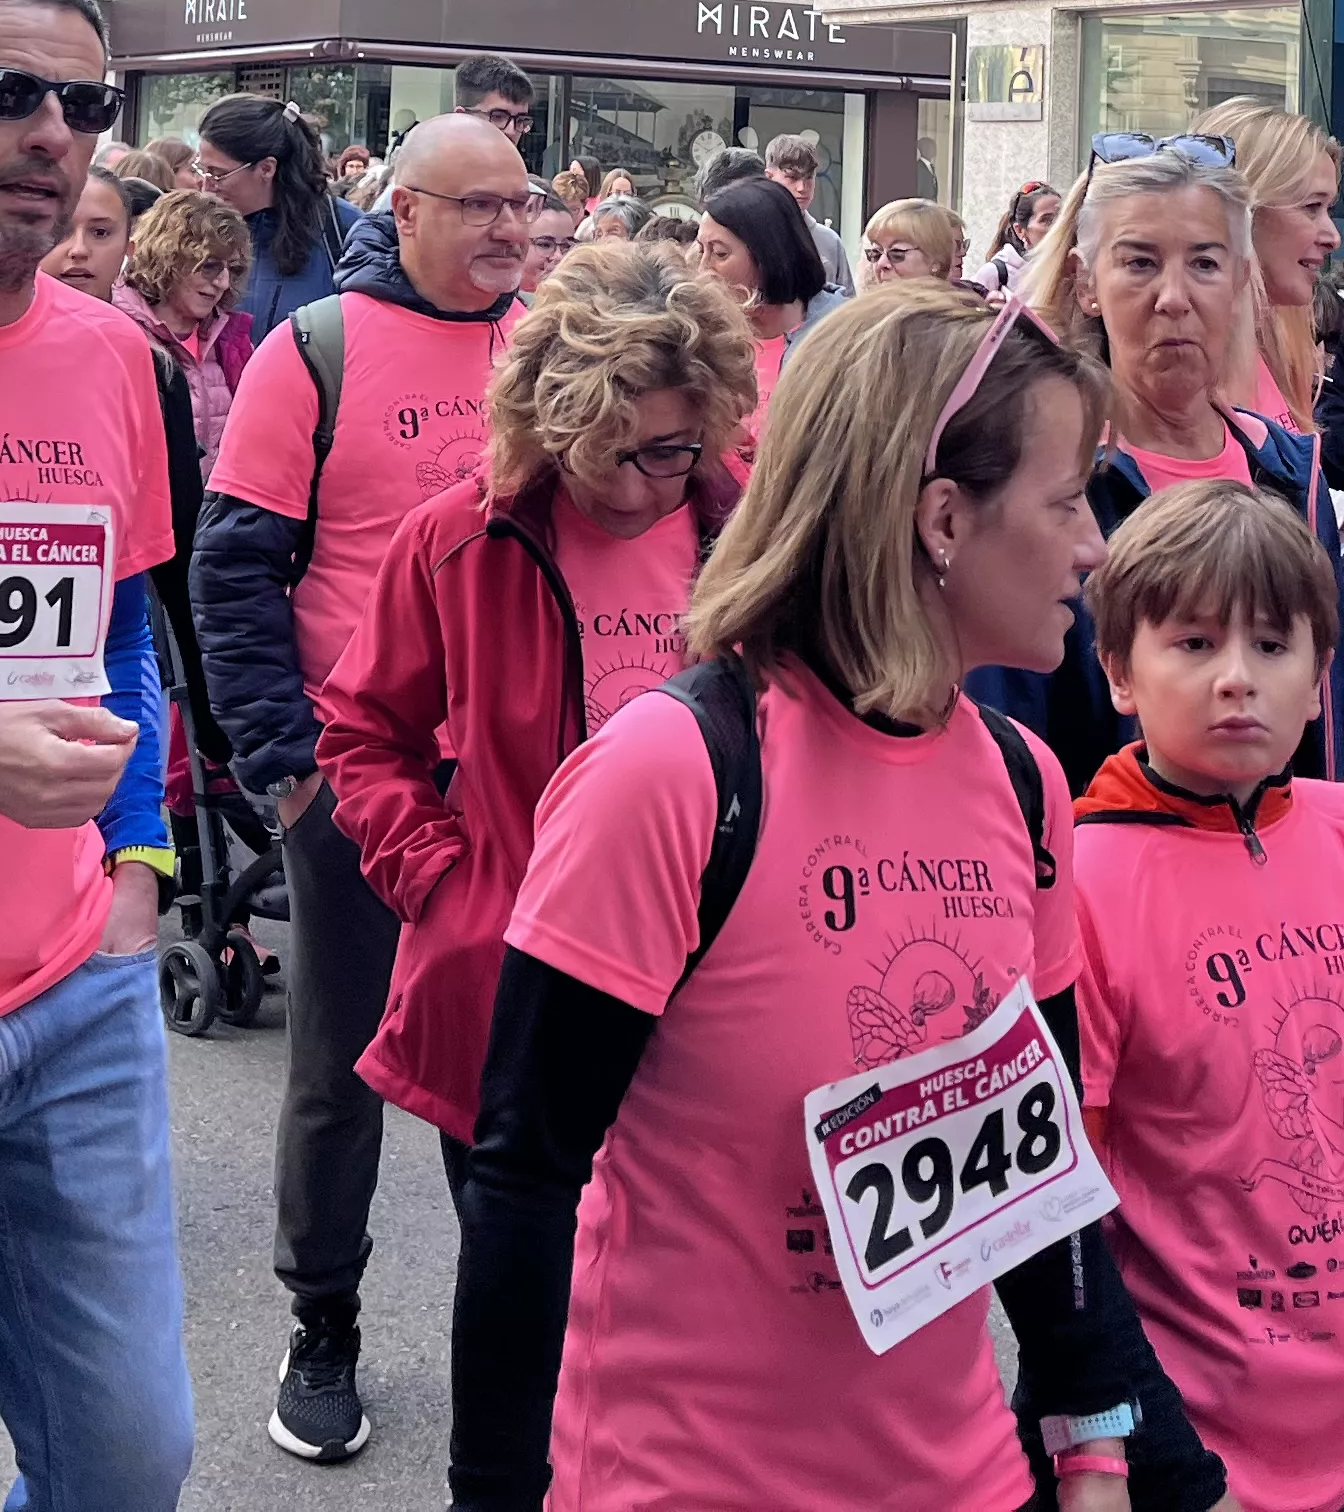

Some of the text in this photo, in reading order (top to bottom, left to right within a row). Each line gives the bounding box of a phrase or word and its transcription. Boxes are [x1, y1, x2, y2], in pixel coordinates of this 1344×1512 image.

[697, 1, 846, 44] MIRATE
[728, 46, 816, 62] MENSWEAR
[37, 466, 105, 488] HUESCA
[11, 543, 33, 562] EL
[36, 540, 99, 563] CÁNCER
[822, 850, 994, 932] 9ª CÁNCER
[942, 895, 1015, 919] HUESCA
[1206, 948, 1253, 1009] 9ª
[839, 1037, 1045, 1156] CONTRA EL CÁNCER
[918, 1058, 988, 1099] HUESCA
[845, 1081, 1061, 1273] 2948
